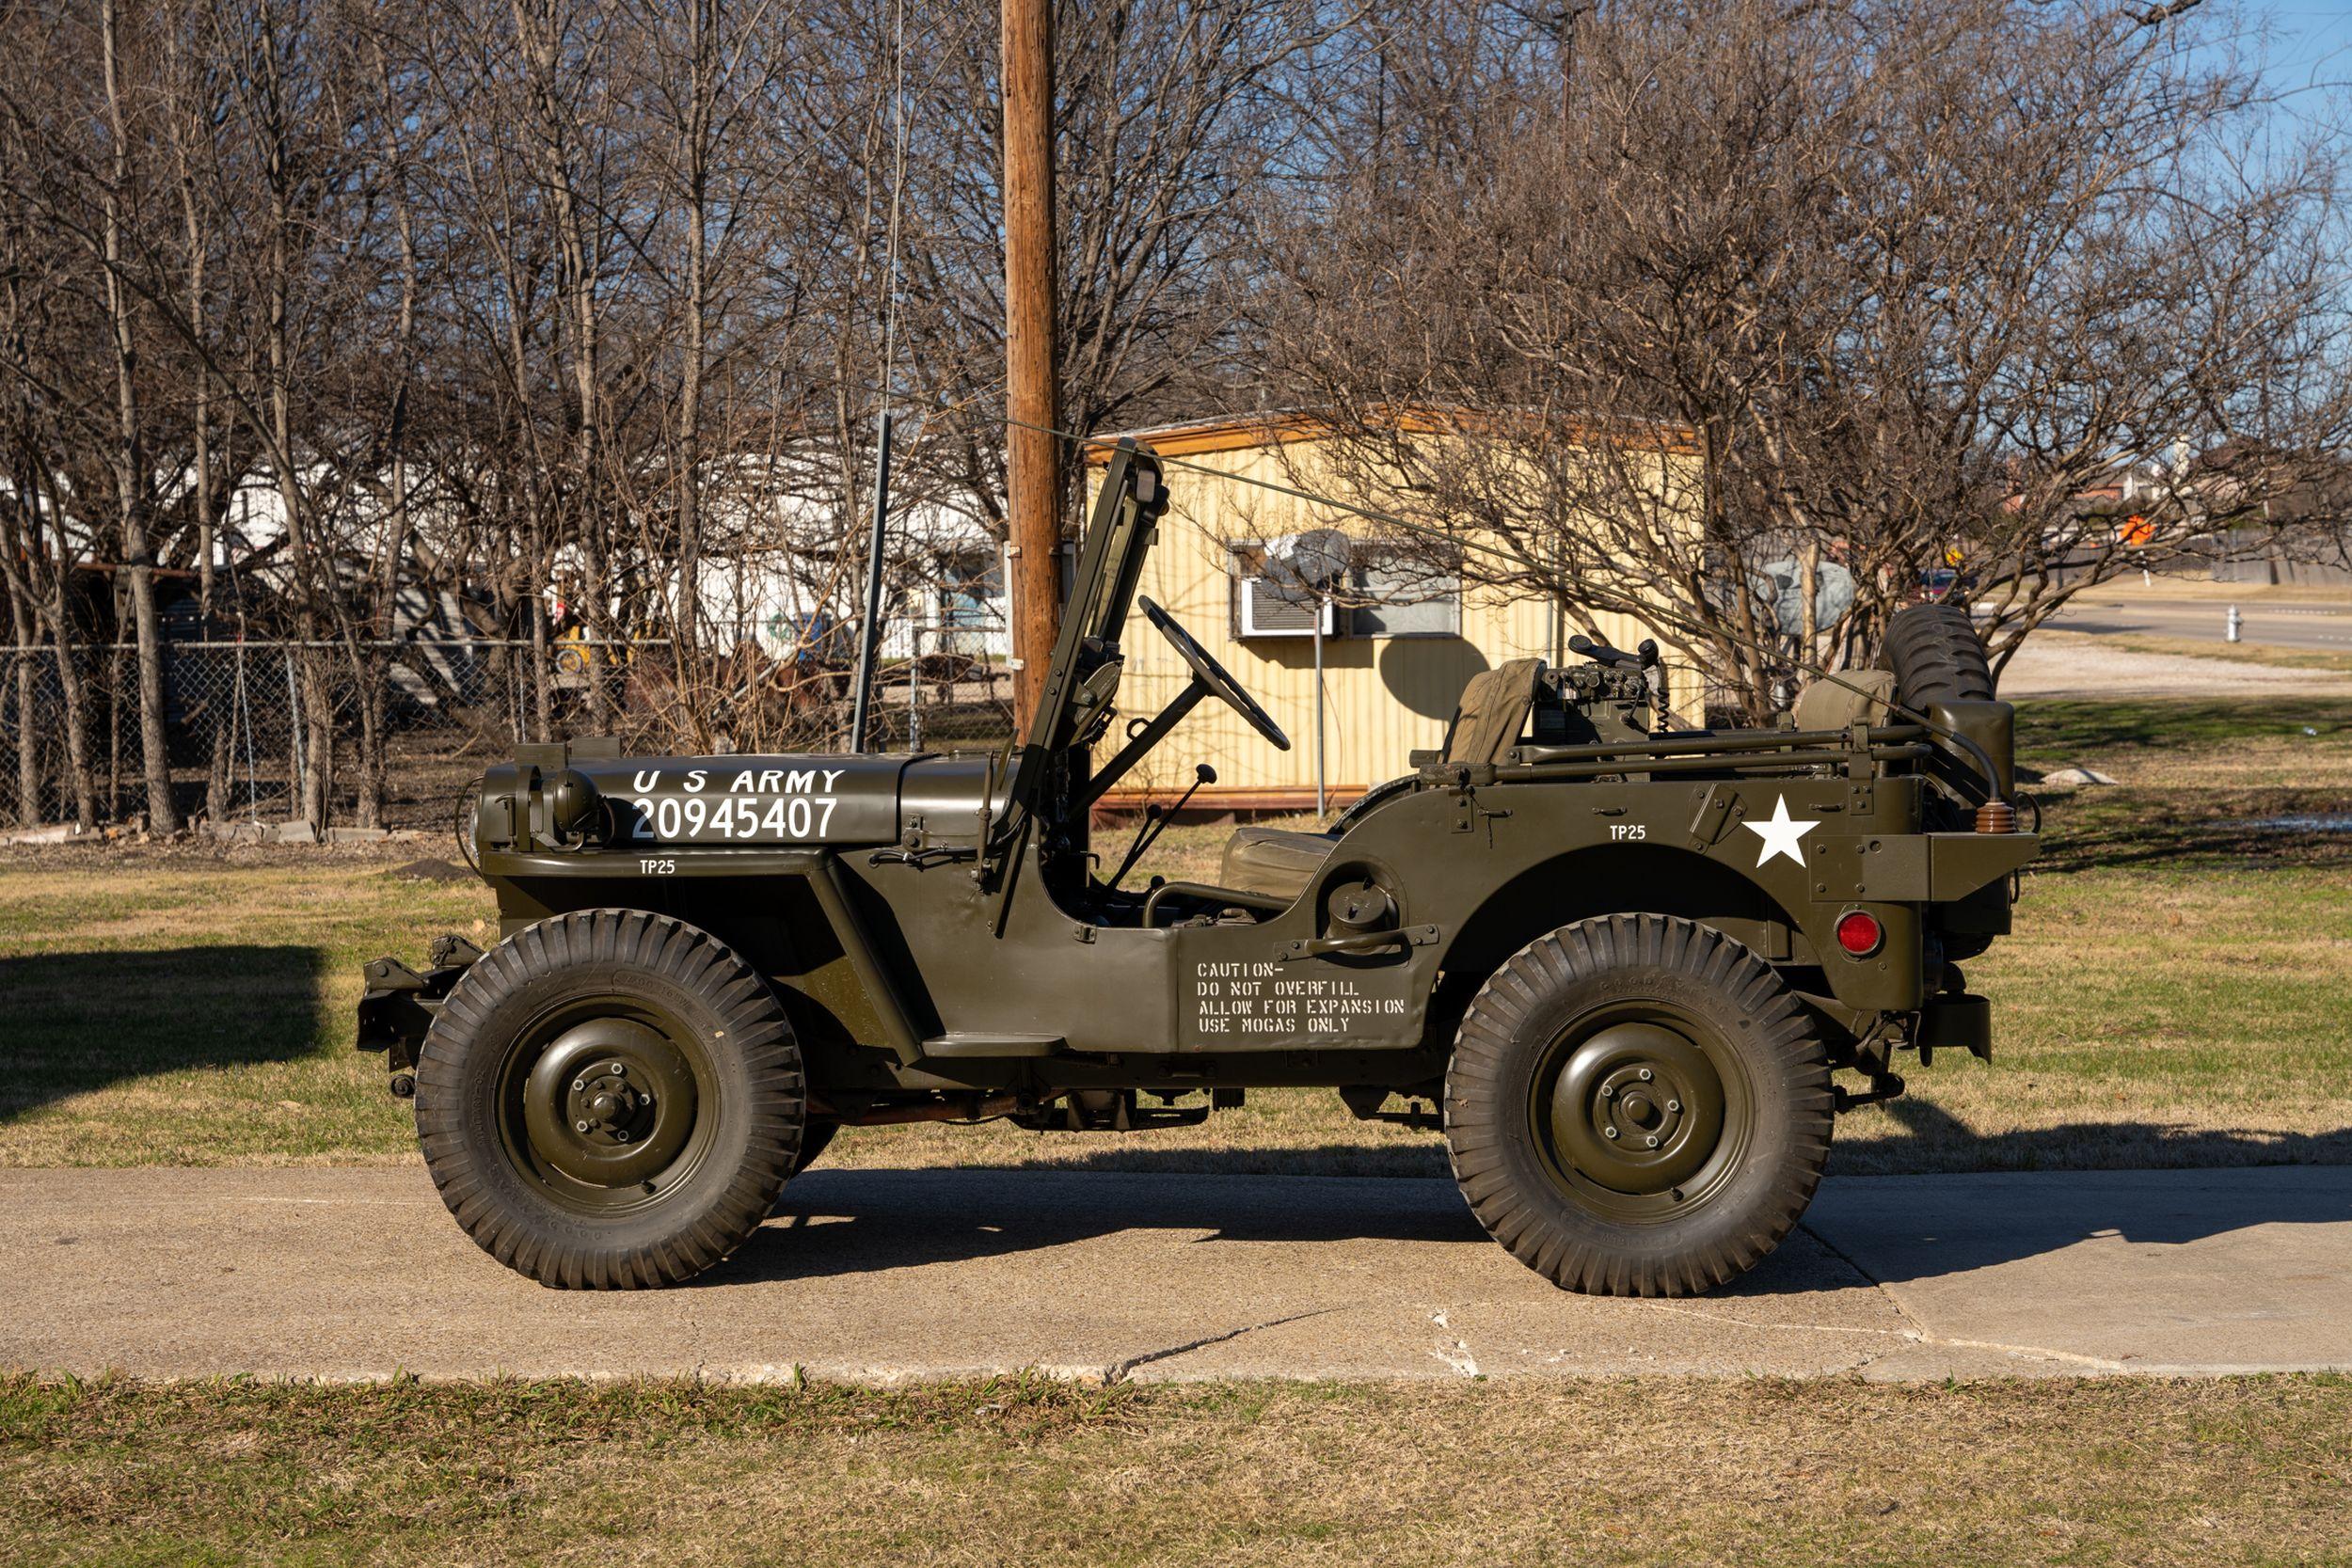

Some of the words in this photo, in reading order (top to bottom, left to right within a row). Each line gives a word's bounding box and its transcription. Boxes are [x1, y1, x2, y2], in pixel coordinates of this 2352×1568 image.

[633, 770, 661, 793] U
[683, 770, 708, 793] S
[729, 770, 846, 794] ARMY
[631, 798, 837, 838] 20945407
[1610, 824, 1646, 840] TP25
[640, 860, 675, 875] TP25
[1197, 962, 1284, 977] CAUTION-
[1197, 981, 1220, 996] DO
[1231, 981, 1263, 996] NOT
[1275, 981, 1359, 996] OVERFILL
[1199, 1000, 1252, 1015] ALLOW
[1263, 1000, 1296, 1015] FOR
[1307, 999, 1405, 1014] EXPANSION
[1199, 1018, 1231, 1033] USE
[1241, 1018, 1295, 1033] MOGAS
[1308, 1018, 1350, 1033] ONLY
